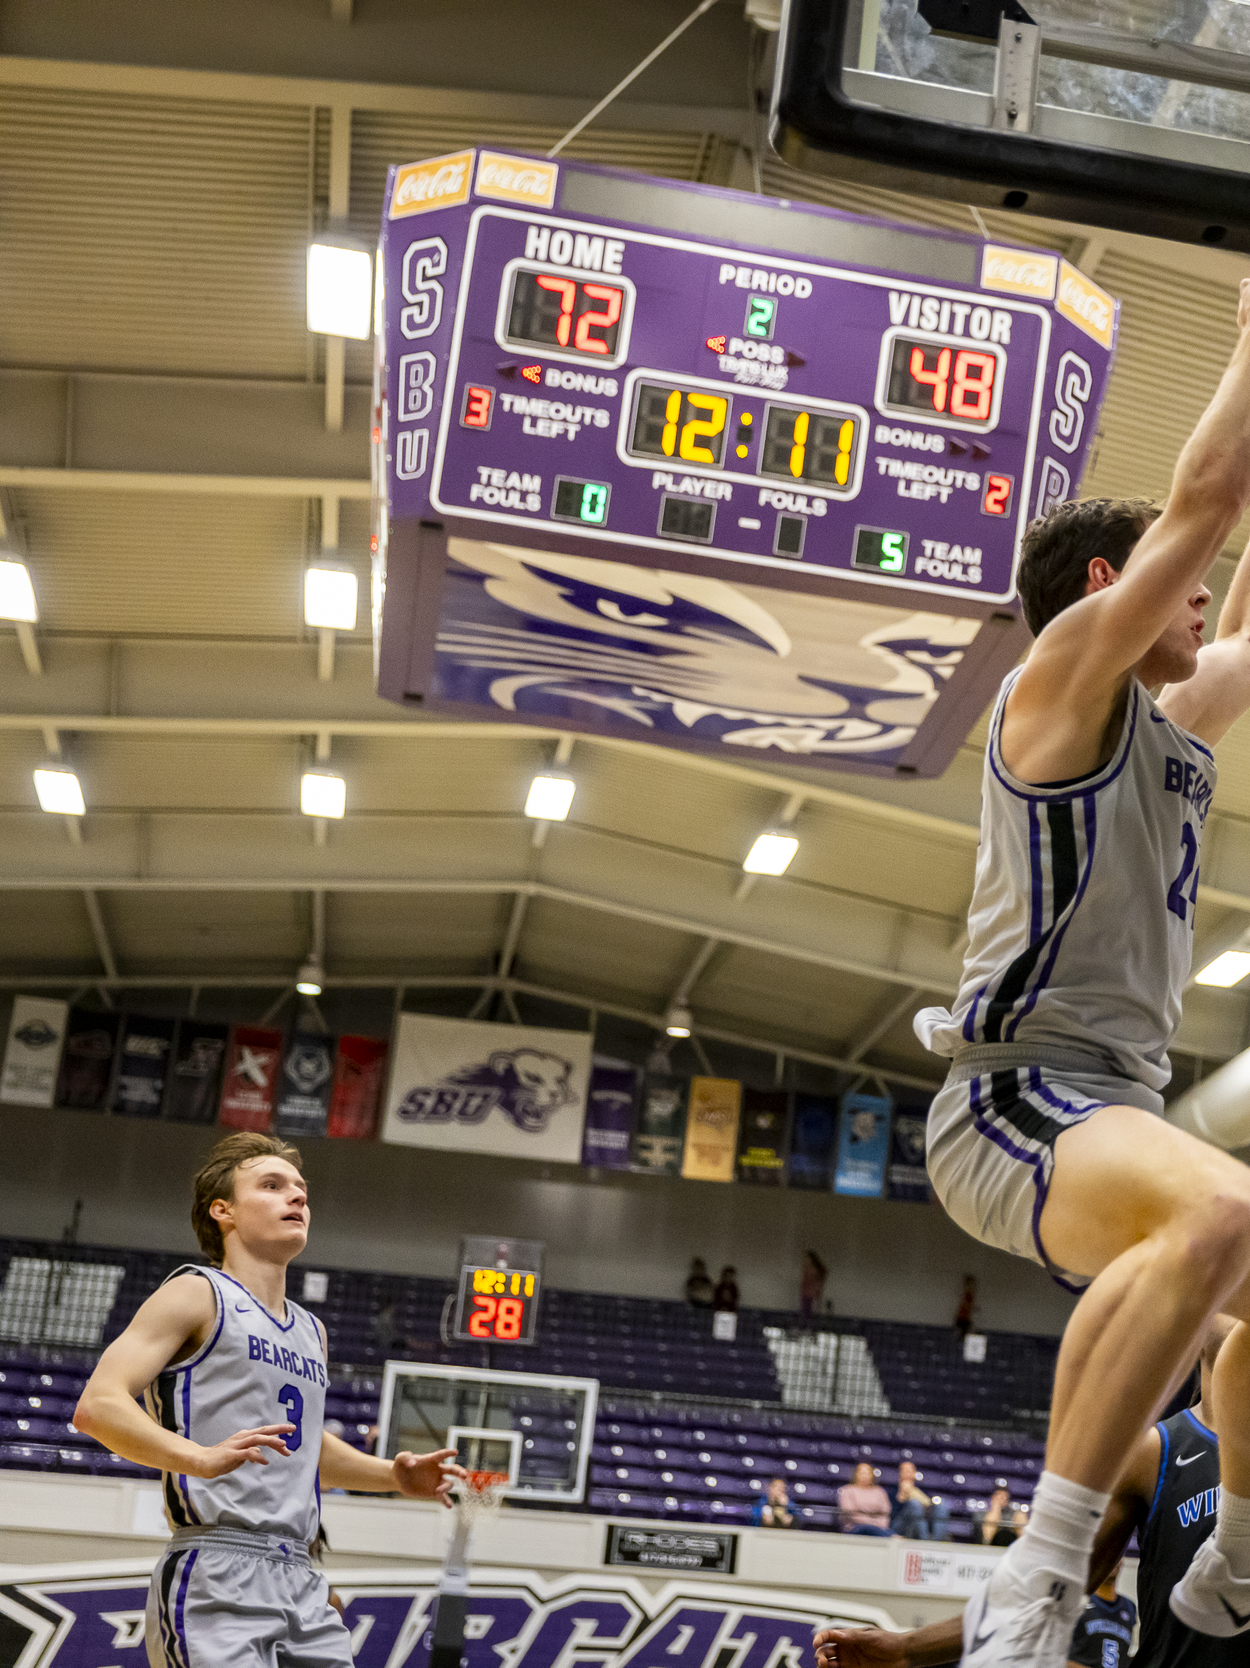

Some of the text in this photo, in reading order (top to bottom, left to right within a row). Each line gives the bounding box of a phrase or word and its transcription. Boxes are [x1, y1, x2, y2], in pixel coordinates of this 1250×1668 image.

[525, 225, 625, 274] HOME
[719, 264, 812, 299] PERIOD
[536, 275, 623, 354] 72
[748, 298, 773, 336] 2
[888, 291, 1012, 344] VISITOR
[545, 368, 618, 397] BONUS
[909, 347, 996, 420] 48
[464, 387, 491, 427] 3
[499, 393, 610, 428] TIMEOUTS
[522, 416, 581, 441] LEFT
[661, 390, 854, 485] 12:11
[875, 425, 945, 453] BONUS
[477, 465, 542, 493] TEAM
[876, 457, 980, 491] TIMEOUTS
[897, 480, 953, 504] LEFT
[470, 483, 541, 512] FOULS
[580, 483, 607, 523] 0
[652, 471, 827, 517] PLAYER FOULS
[985, 475, 1011, 515] 2
[879, 532, 904, 572] 5
[915, 556, 982, 584] FOULS
[922, 539, 982, 565] TEAM
[396, 1086, 505, 1125] SBU
[468, 1295, 524, 1340] 28
[248, 1334, 326, 1387] BEARCATS
[278, 1383, 304, 1452] 3
